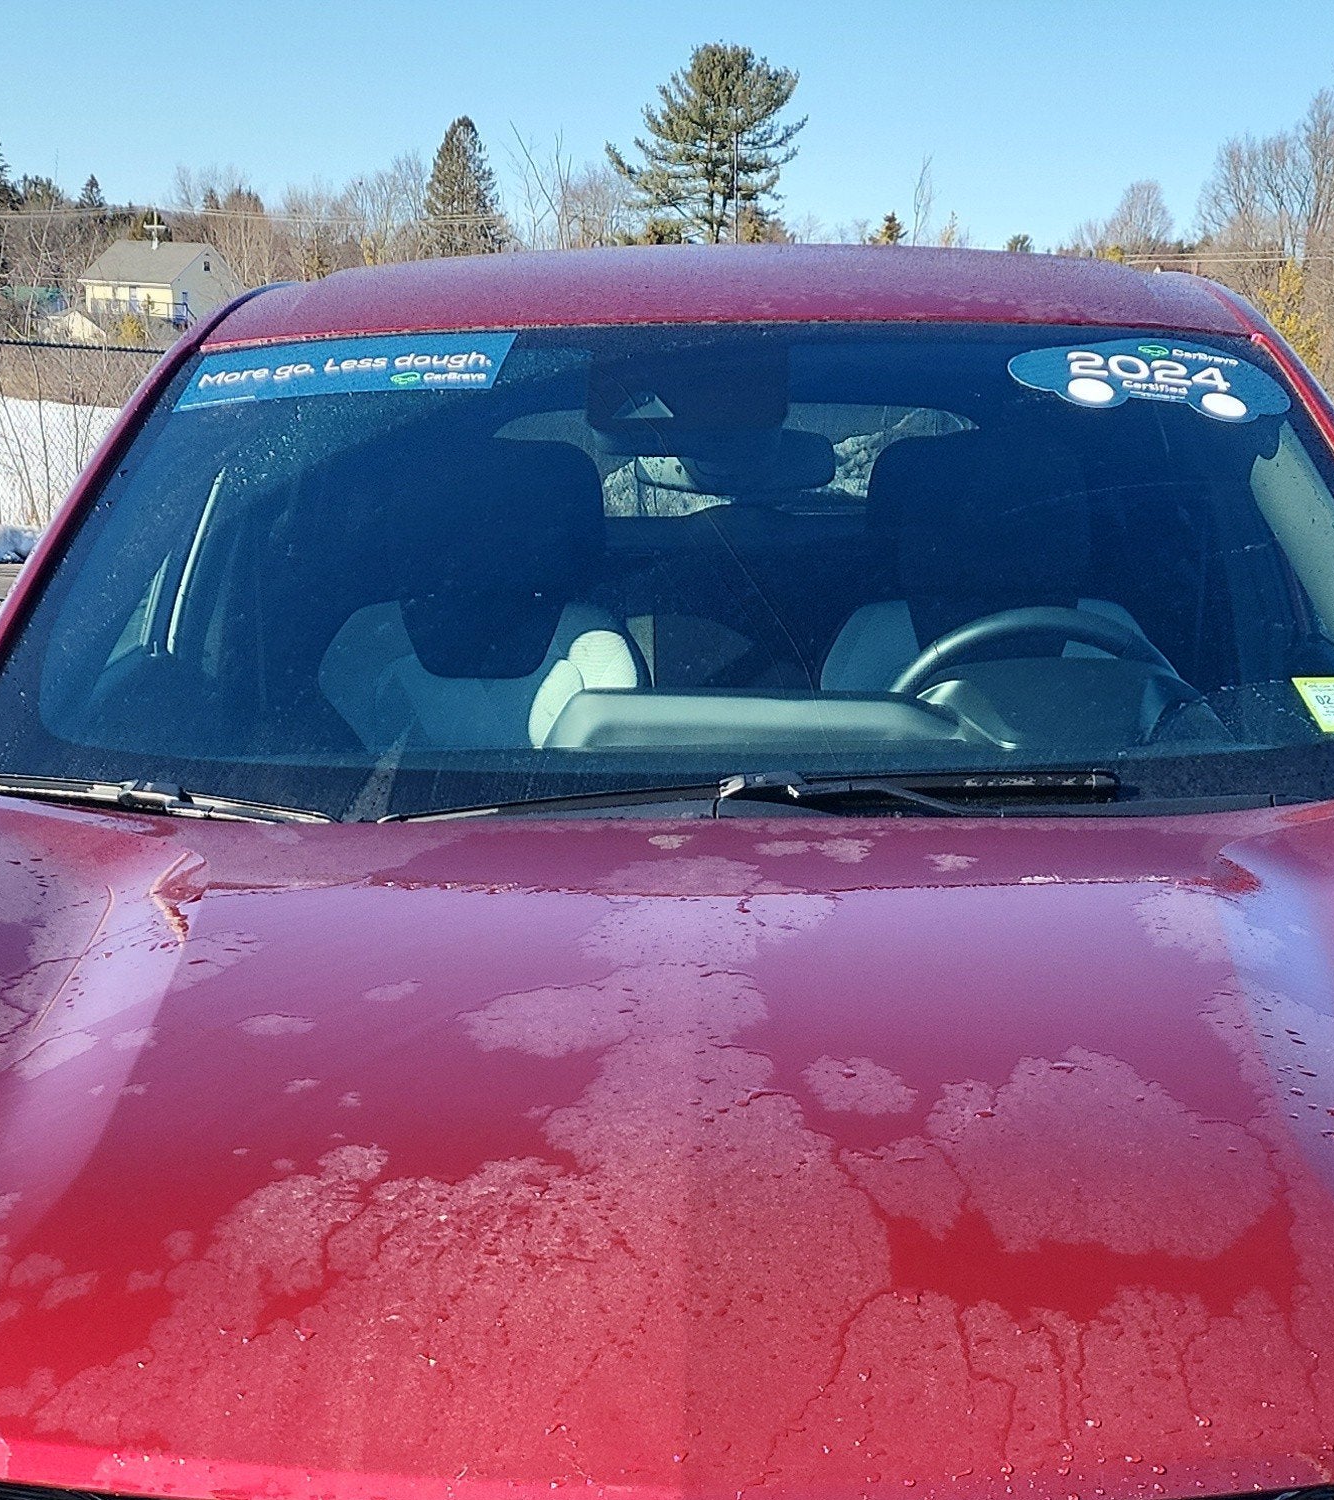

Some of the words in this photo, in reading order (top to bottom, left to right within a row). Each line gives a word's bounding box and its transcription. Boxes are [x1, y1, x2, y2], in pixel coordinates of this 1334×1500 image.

[1171, 348, 1239, 367] CarBravo
[198, 367, 269, 389] More
[273, 363, 315, 381] go.
[324, 357, 388, 373] Less
[394, 351, 492, 369] dough.
[423, 372, 487, 383] CarBravo
[1067, 351, 1231, 392] 2024
[1121, 379, 1189, 395] Certified
